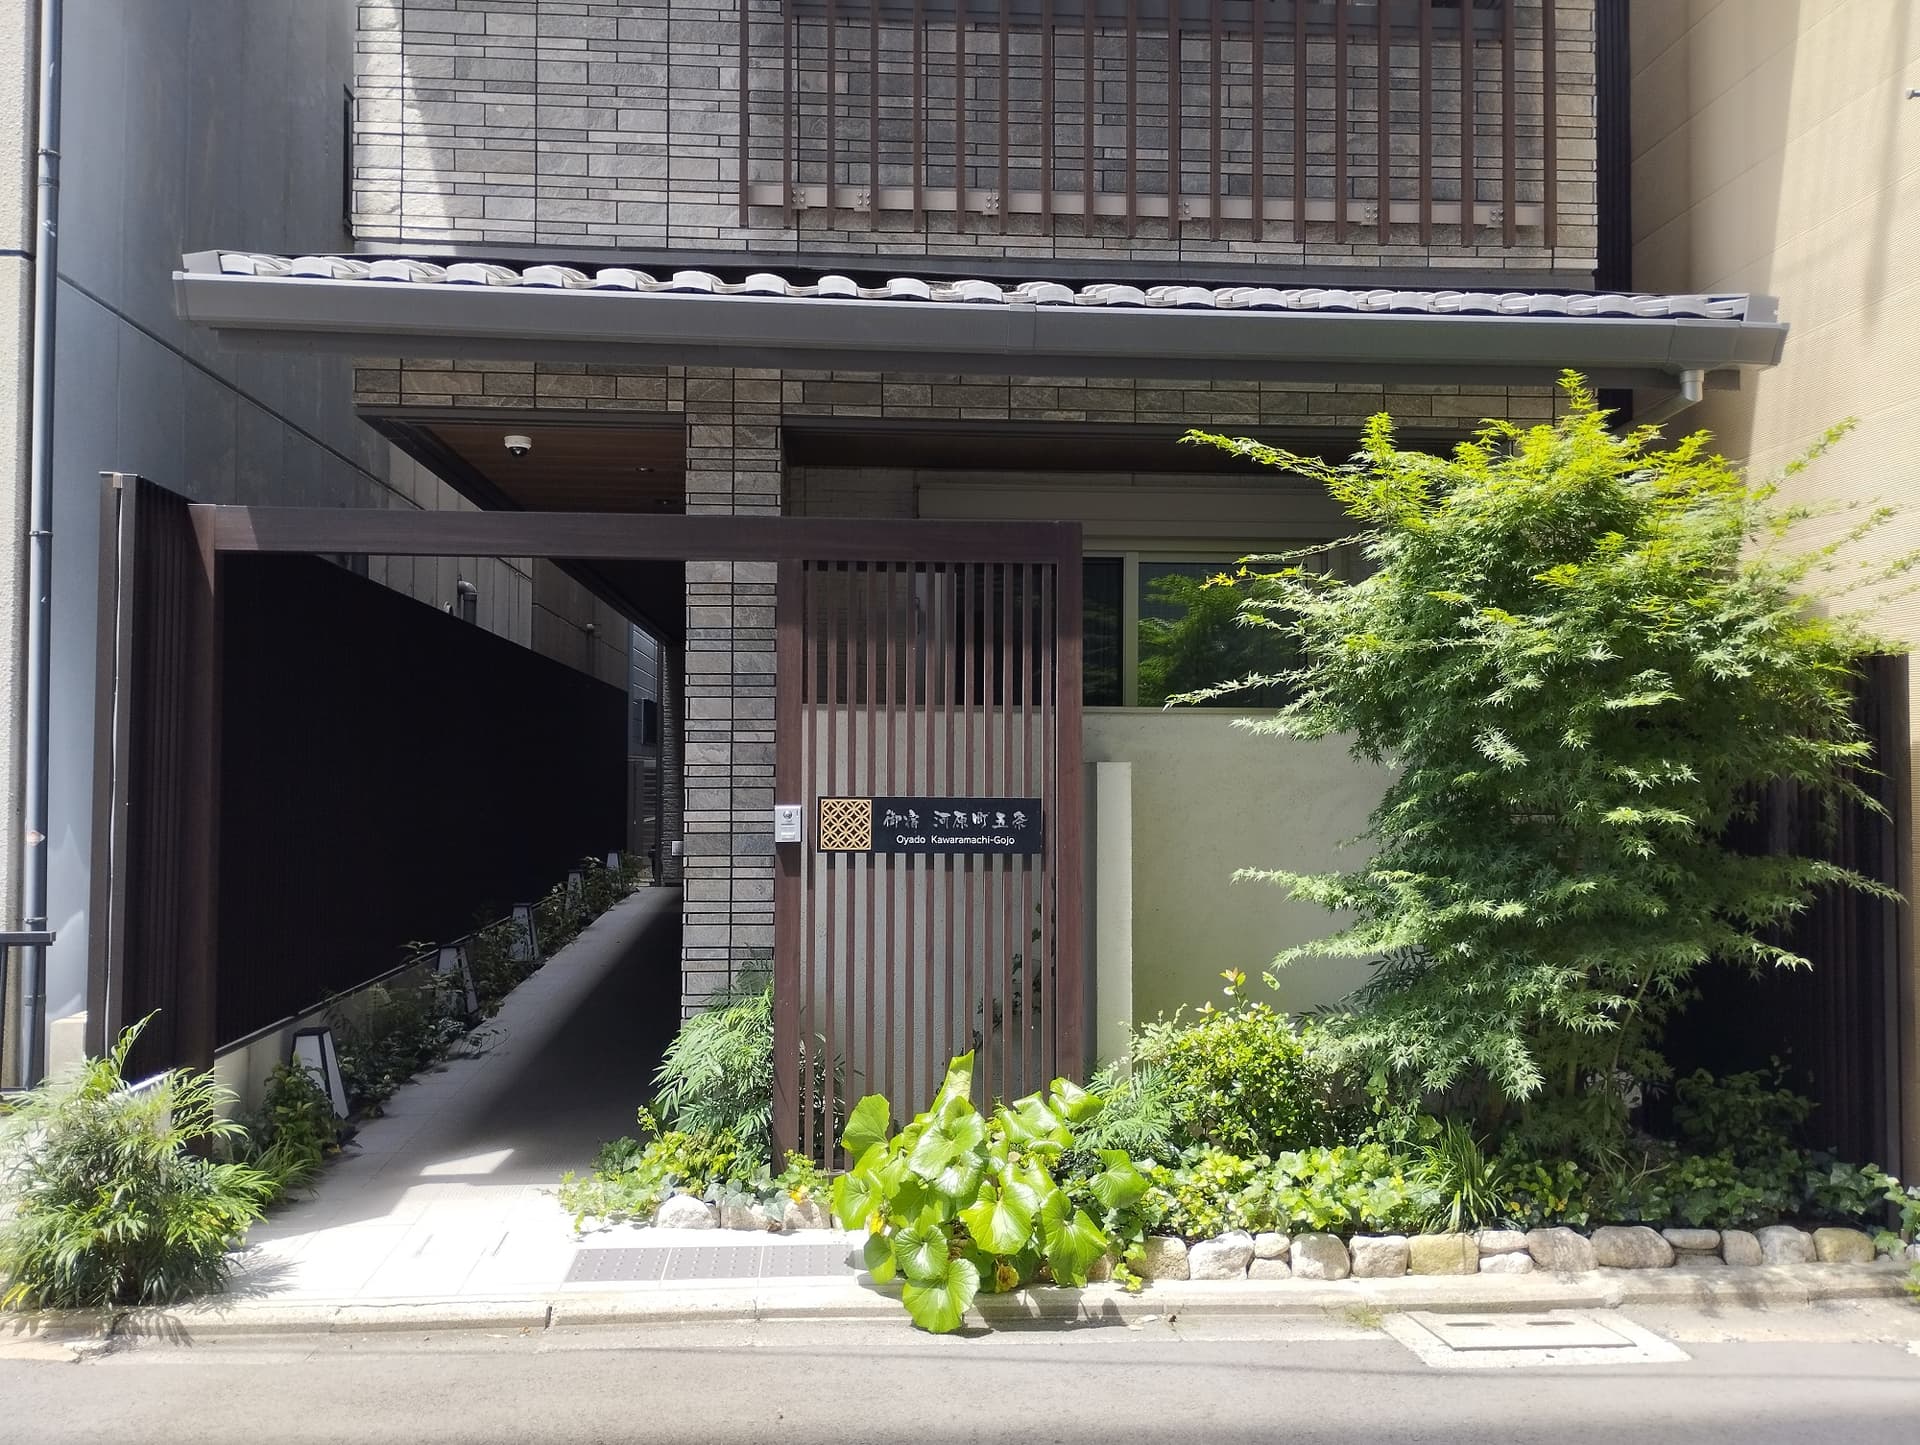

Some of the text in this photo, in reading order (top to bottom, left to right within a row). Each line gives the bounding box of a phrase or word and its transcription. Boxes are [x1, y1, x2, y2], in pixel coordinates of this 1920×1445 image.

[932, 809, 1029, 830] 河原町五条
[896, 835, 1015, 846] Oyado Kawaramachi-Gojo
